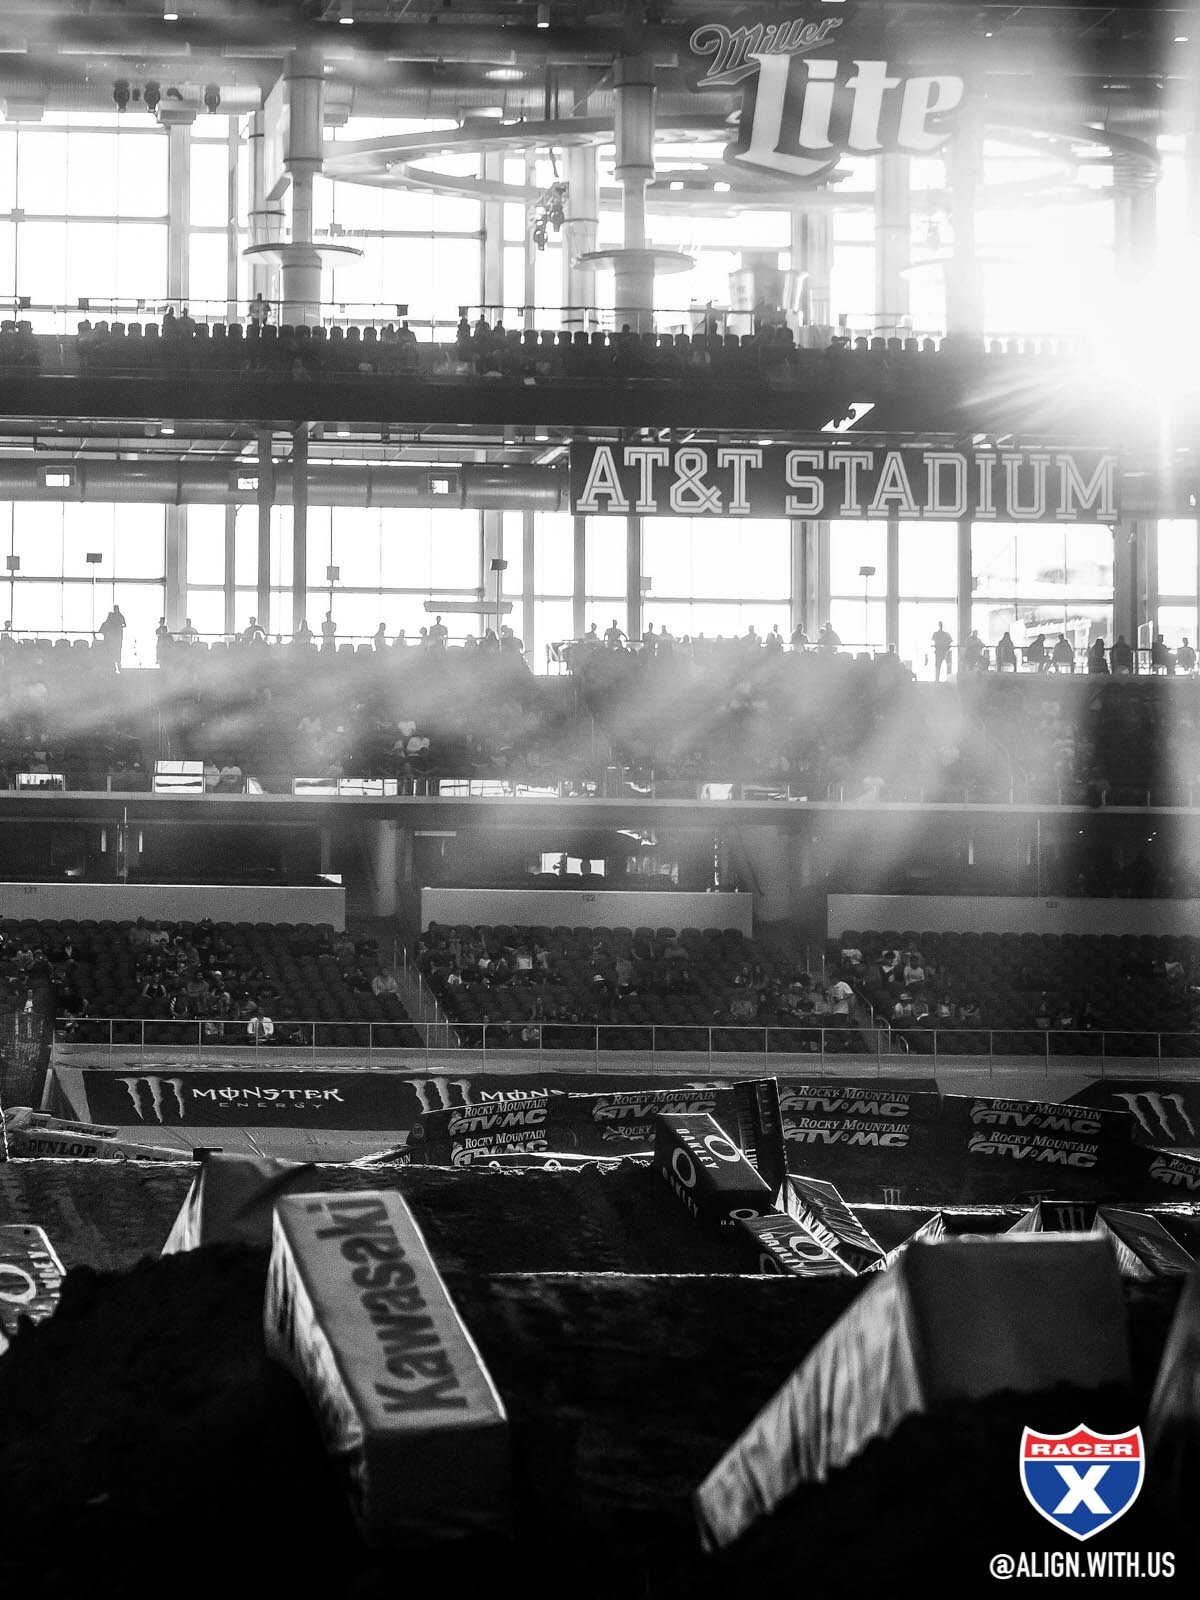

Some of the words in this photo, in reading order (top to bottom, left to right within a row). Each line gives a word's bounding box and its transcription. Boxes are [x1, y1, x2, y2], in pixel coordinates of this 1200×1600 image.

[690, 18, 843, 77] Miller
[735, 54, 964, 176] Lite
[576, 446, 763, 515] AT&T
[785, 449, 1118, 519] STADIUM
[800, 1086, 841, 1099] ROCKY
[842, 1088, 911, 1104] MOUNTAIN
[218, 1102, 325, 1110] ENERGY
[465, 1103, 495, 1118] ROCKY
[497, 1098, 548, 1113] MOUNTAIN
[991, 1100, 1031, 1114] ROCKY
[1034, 1103, 1102, 1121] MOUNTAIN
[800, 1117, 840, 1130] ROCKY
[842, 1119, 911, 1133] MOUNTAIN
[28, 1138, 99, 1158] DUNLOP
[465, 1135, 494, 1149] ROCKY
[495, 1129, 546, 1146] MOUNTAIN
[676, 1128, 720, 1169] OAKLEY
[990, 1131, 1028, 1145] ROCKY
[1030, 1135, 1099, 1153] MOUNTAIN
[306, 1200, 468, 1413] Kawasaki
